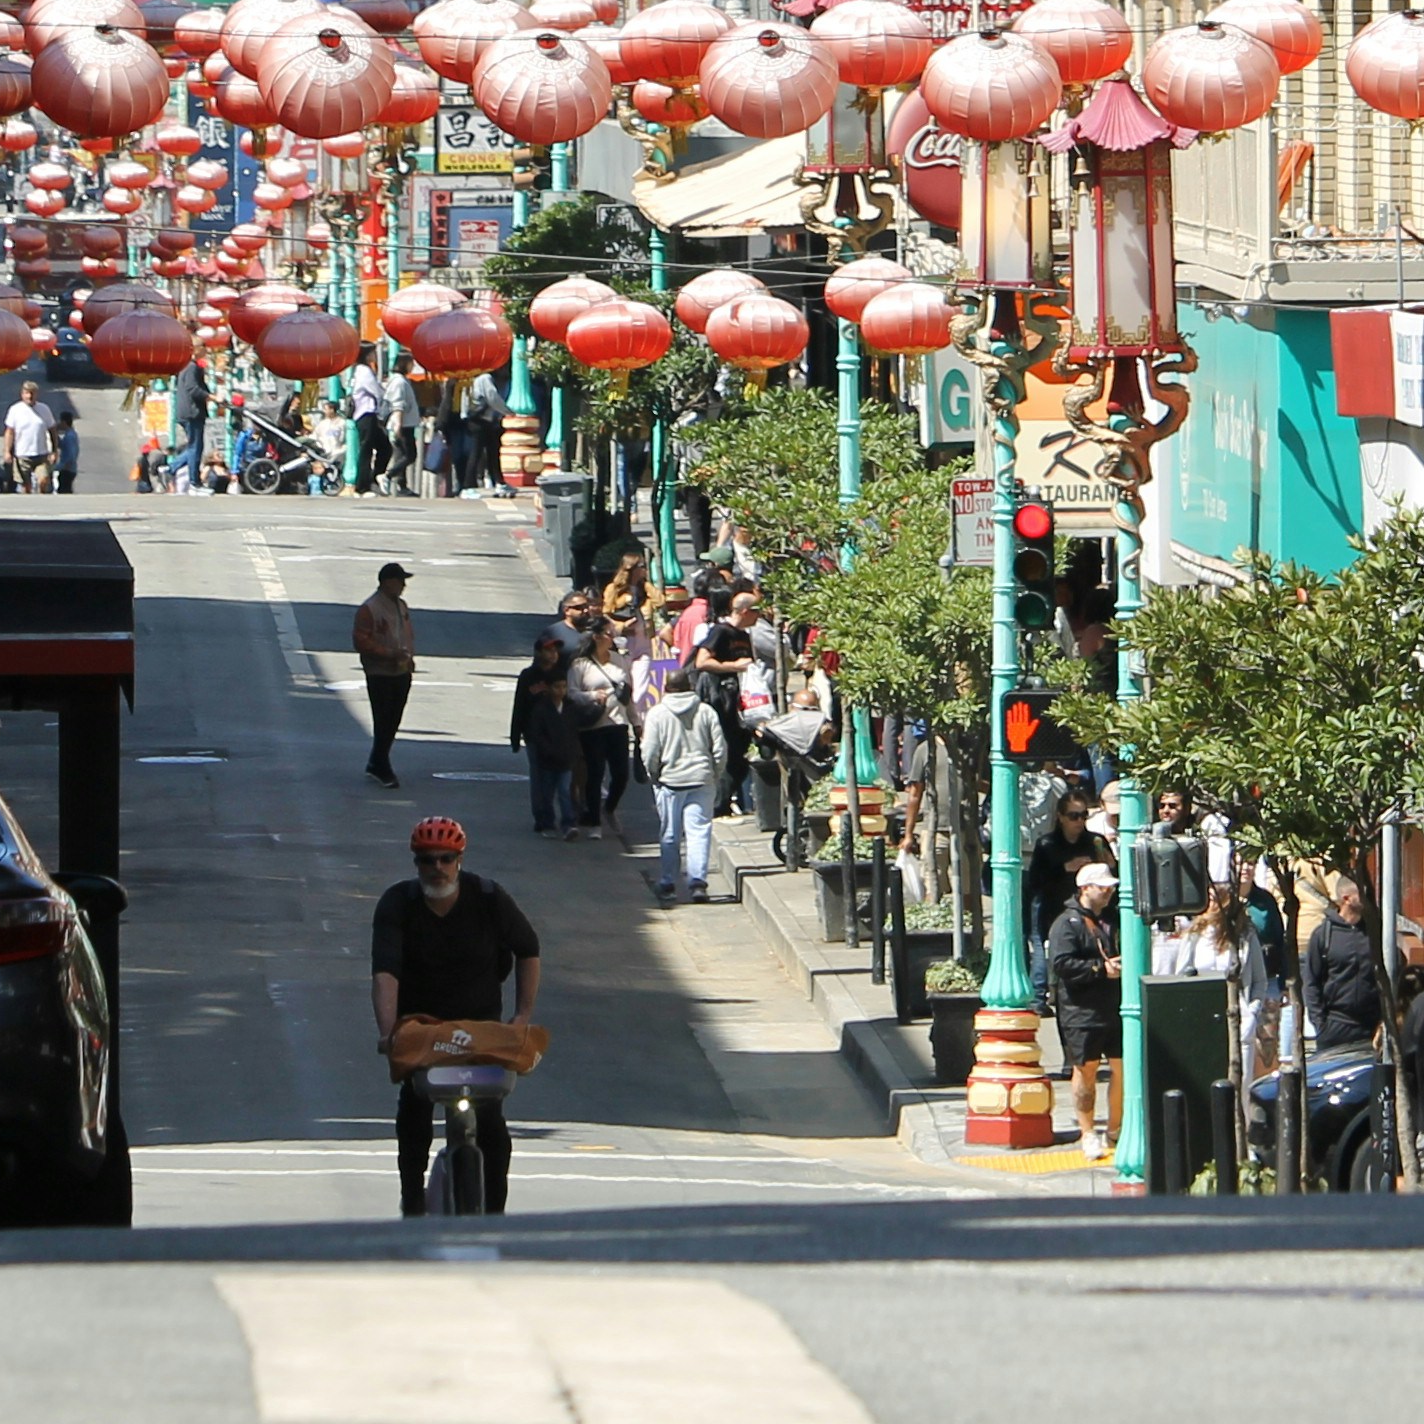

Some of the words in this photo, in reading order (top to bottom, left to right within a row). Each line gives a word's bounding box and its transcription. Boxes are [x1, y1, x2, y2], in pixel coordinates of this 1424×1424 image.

[955, 494, 973, 514] NO
[977, 519, 994, 531] AN
[975, 534, 994, 547] TIM
